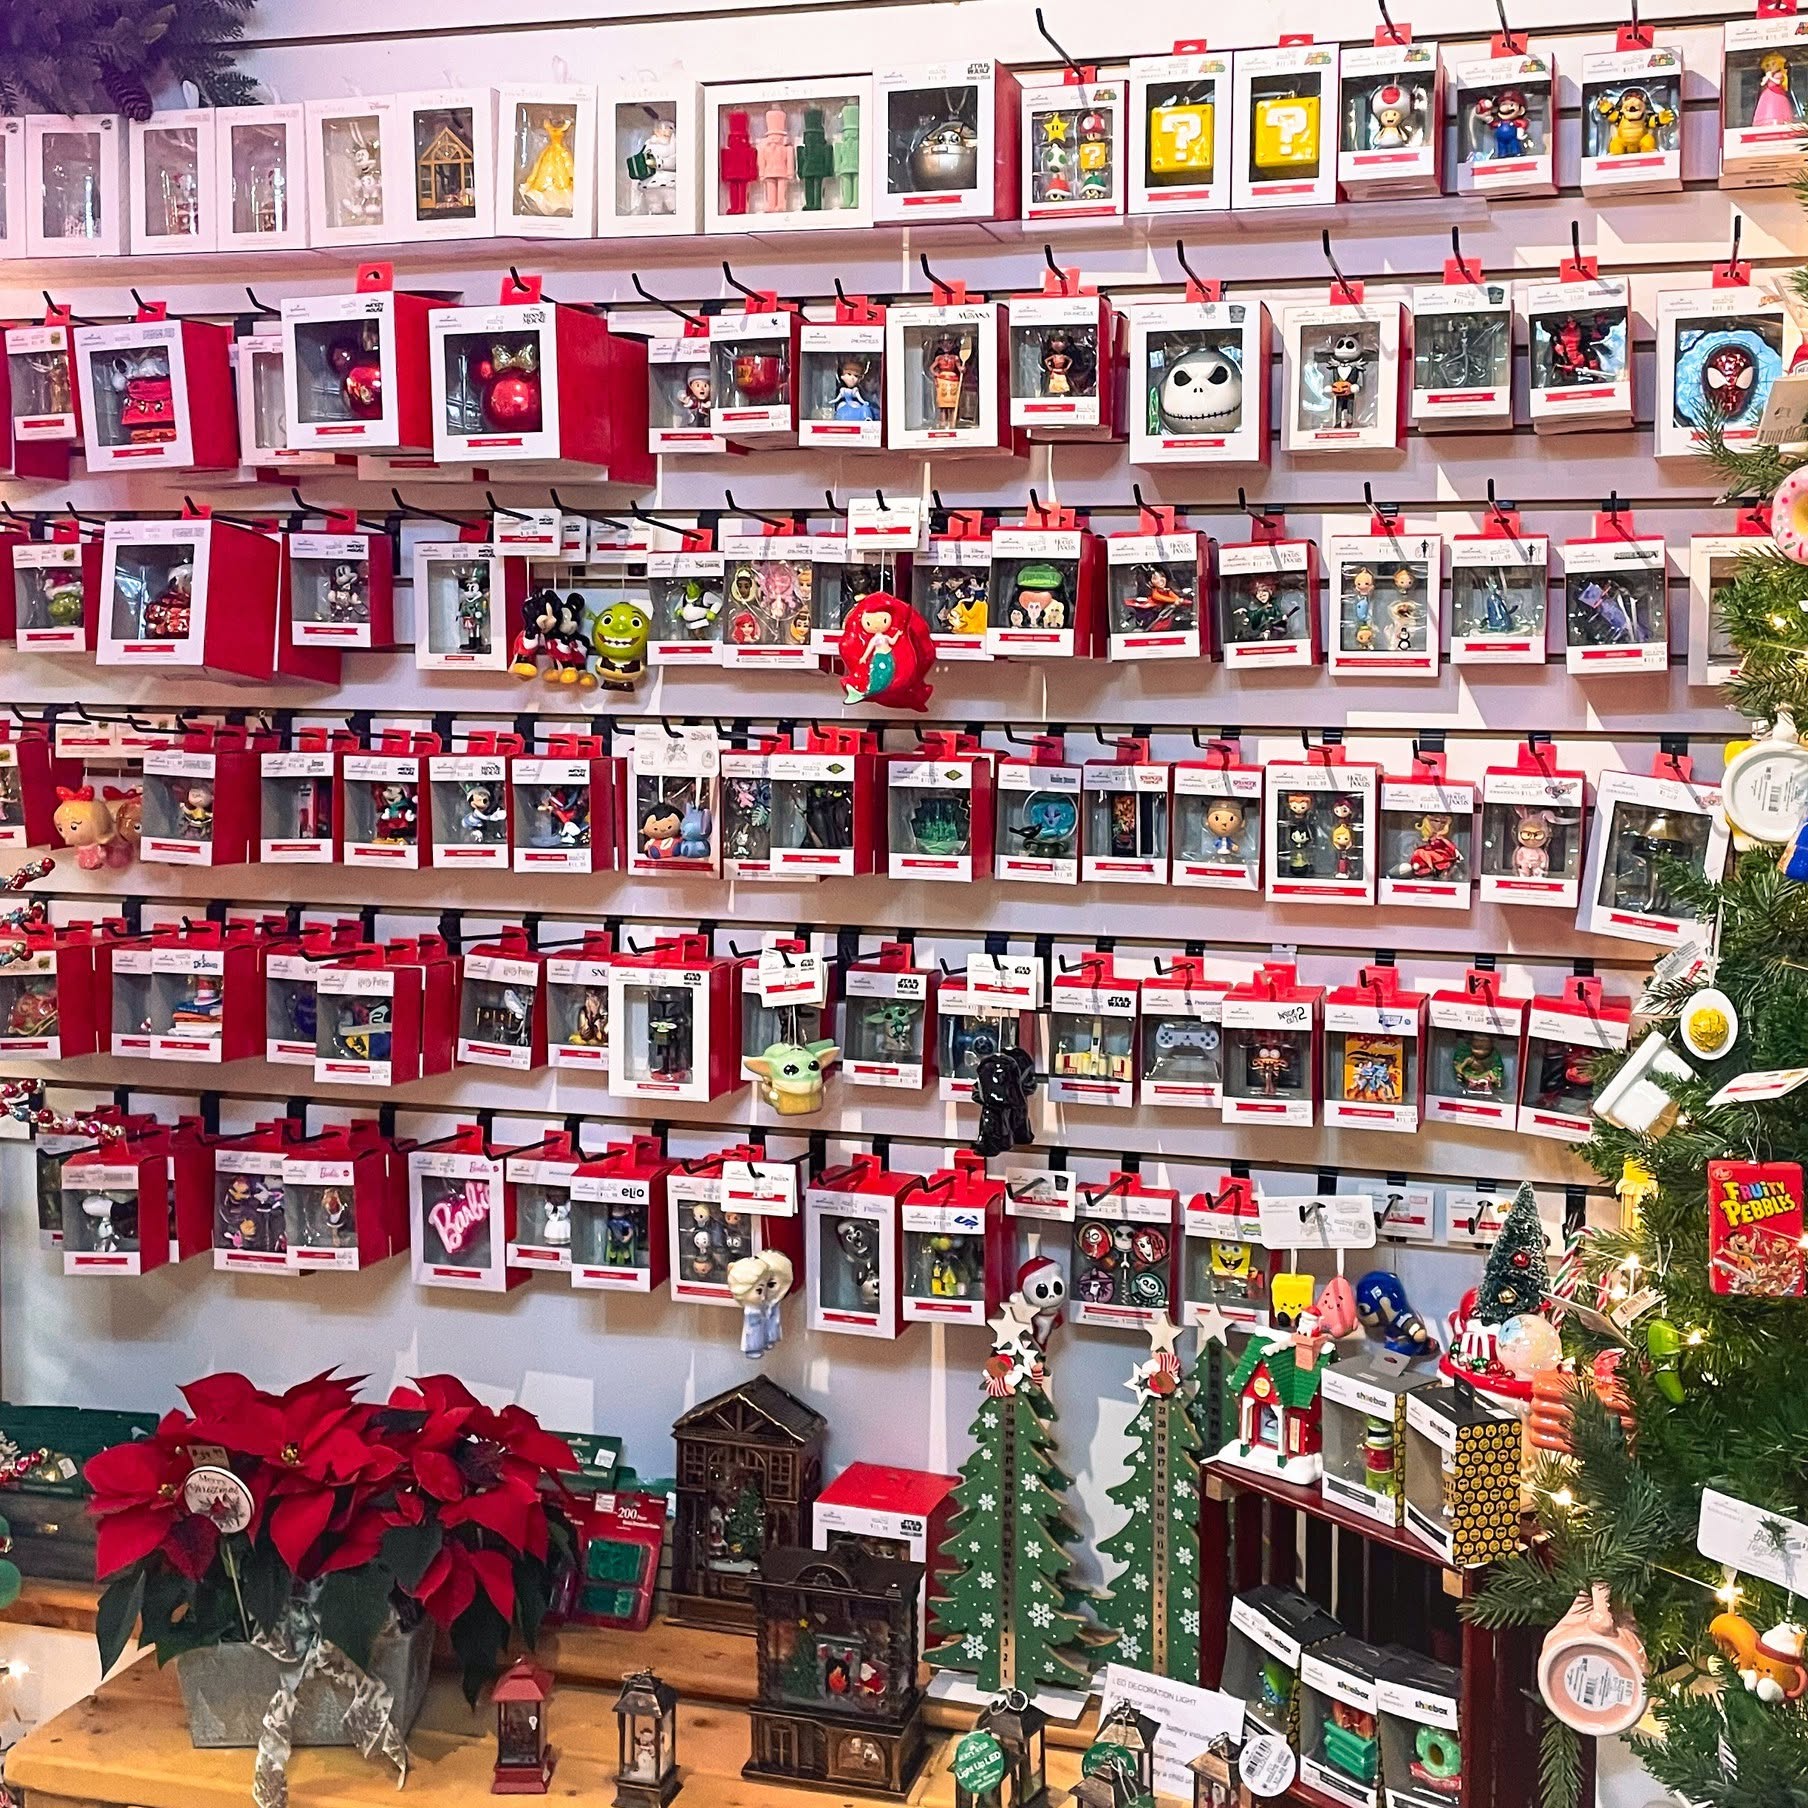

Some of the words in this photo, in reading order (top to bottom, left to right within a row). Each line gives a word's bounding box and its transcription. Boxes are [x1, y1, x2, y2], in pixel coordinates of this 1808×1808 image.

[1297, 1006, 1308, 1020] 2
[1720, 1193, 1796, 1227] PEBBLES
[617, 1507, 638, 1519] 200
[1128, 1682, 1174, 1700] DECORATION
[1175, 1693, 1197, 1707] LIGHT
[1337, 1680, 1369, 1700] shoebox
[1414, 1700, 1448, 1716] shoebox
[956, 1764, 976, 1780] Light
[974, 1759, 985, 1771] Up
[984, 1751, 1001, 1766] LED
